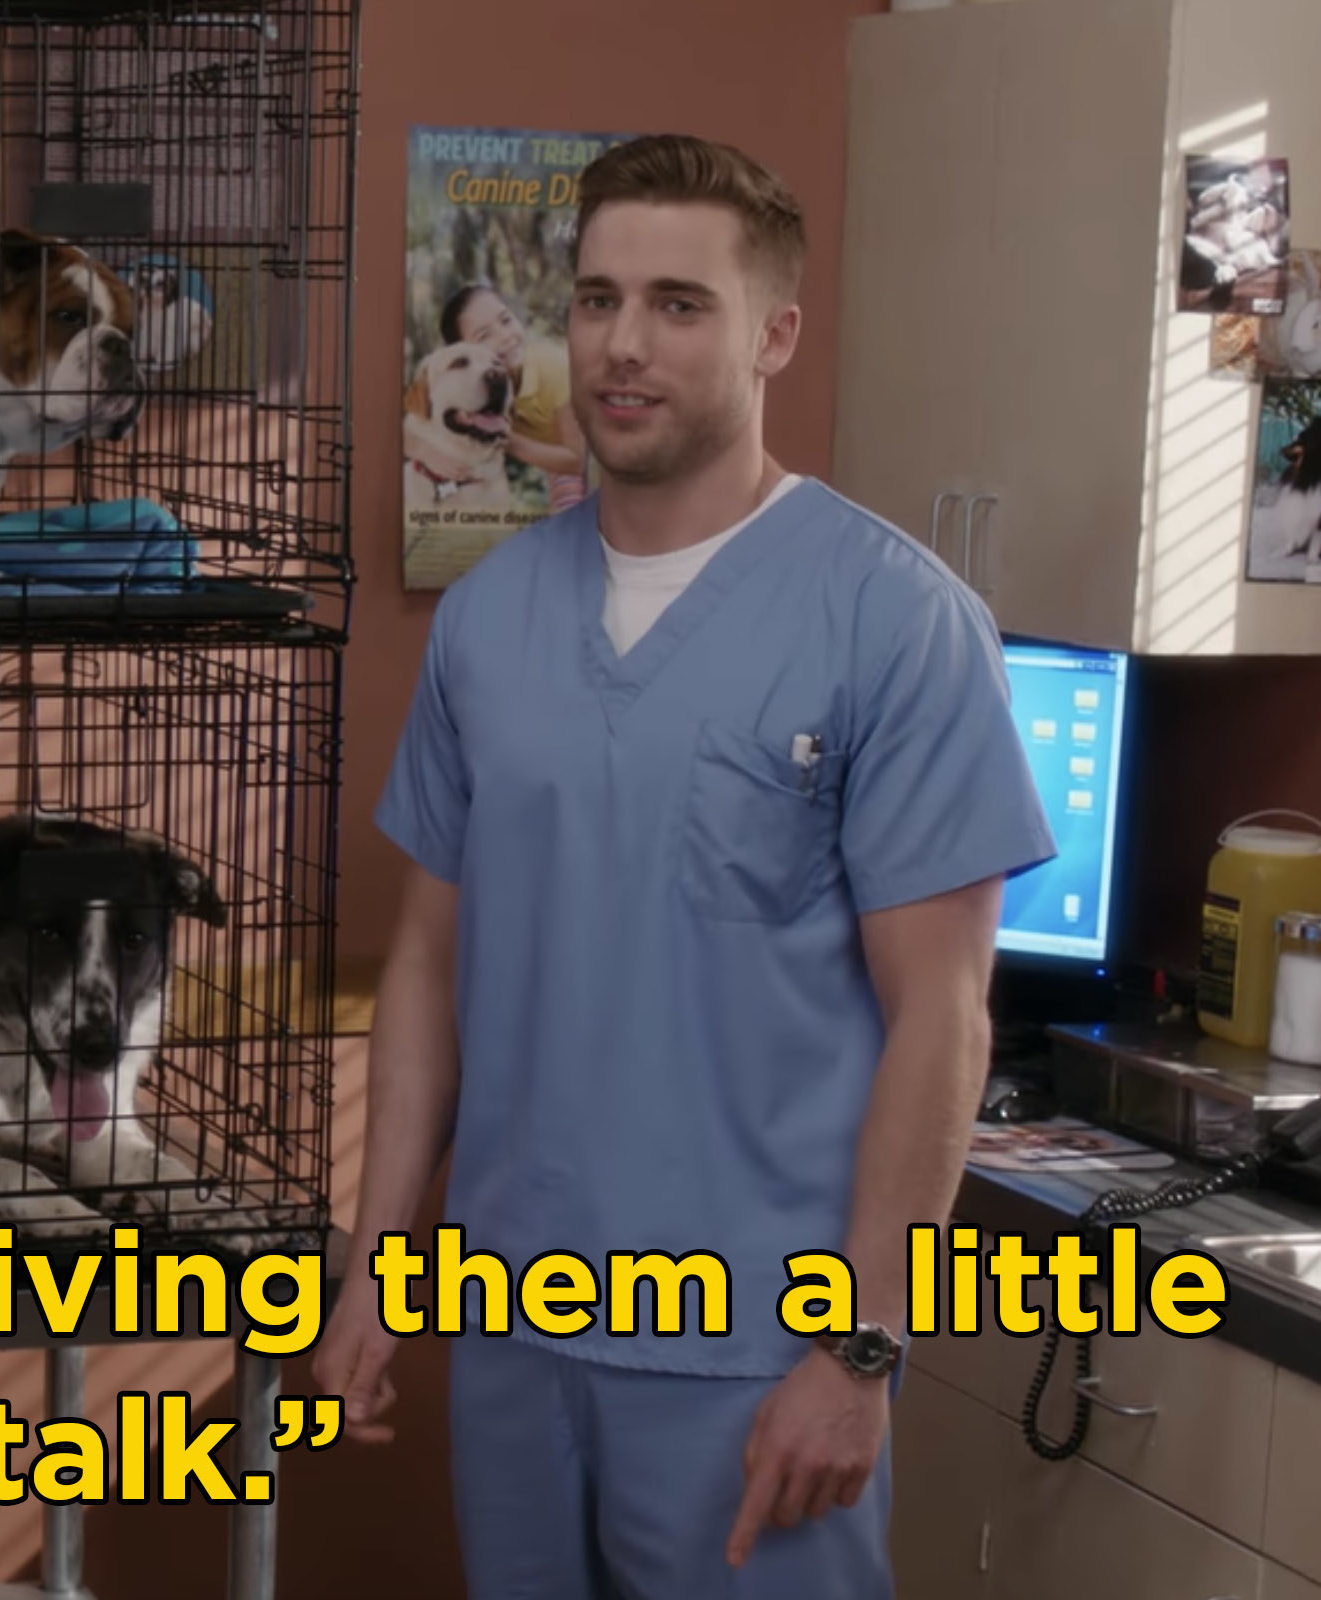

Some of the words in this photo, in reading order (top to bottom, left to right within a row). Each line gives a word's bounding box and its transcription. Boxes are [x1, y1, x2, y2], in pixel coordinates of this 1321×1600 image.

[419, 133, 523, 164] PREVENT
[529, 138, 603, 166] TREAT
[446, 168, 541, 205] Canine
[547, 172, 583, 206] Di
[409, 509, 440, 527] signs
[444, 509, 458, 524] of
[460, 509, 501, 524] canine
